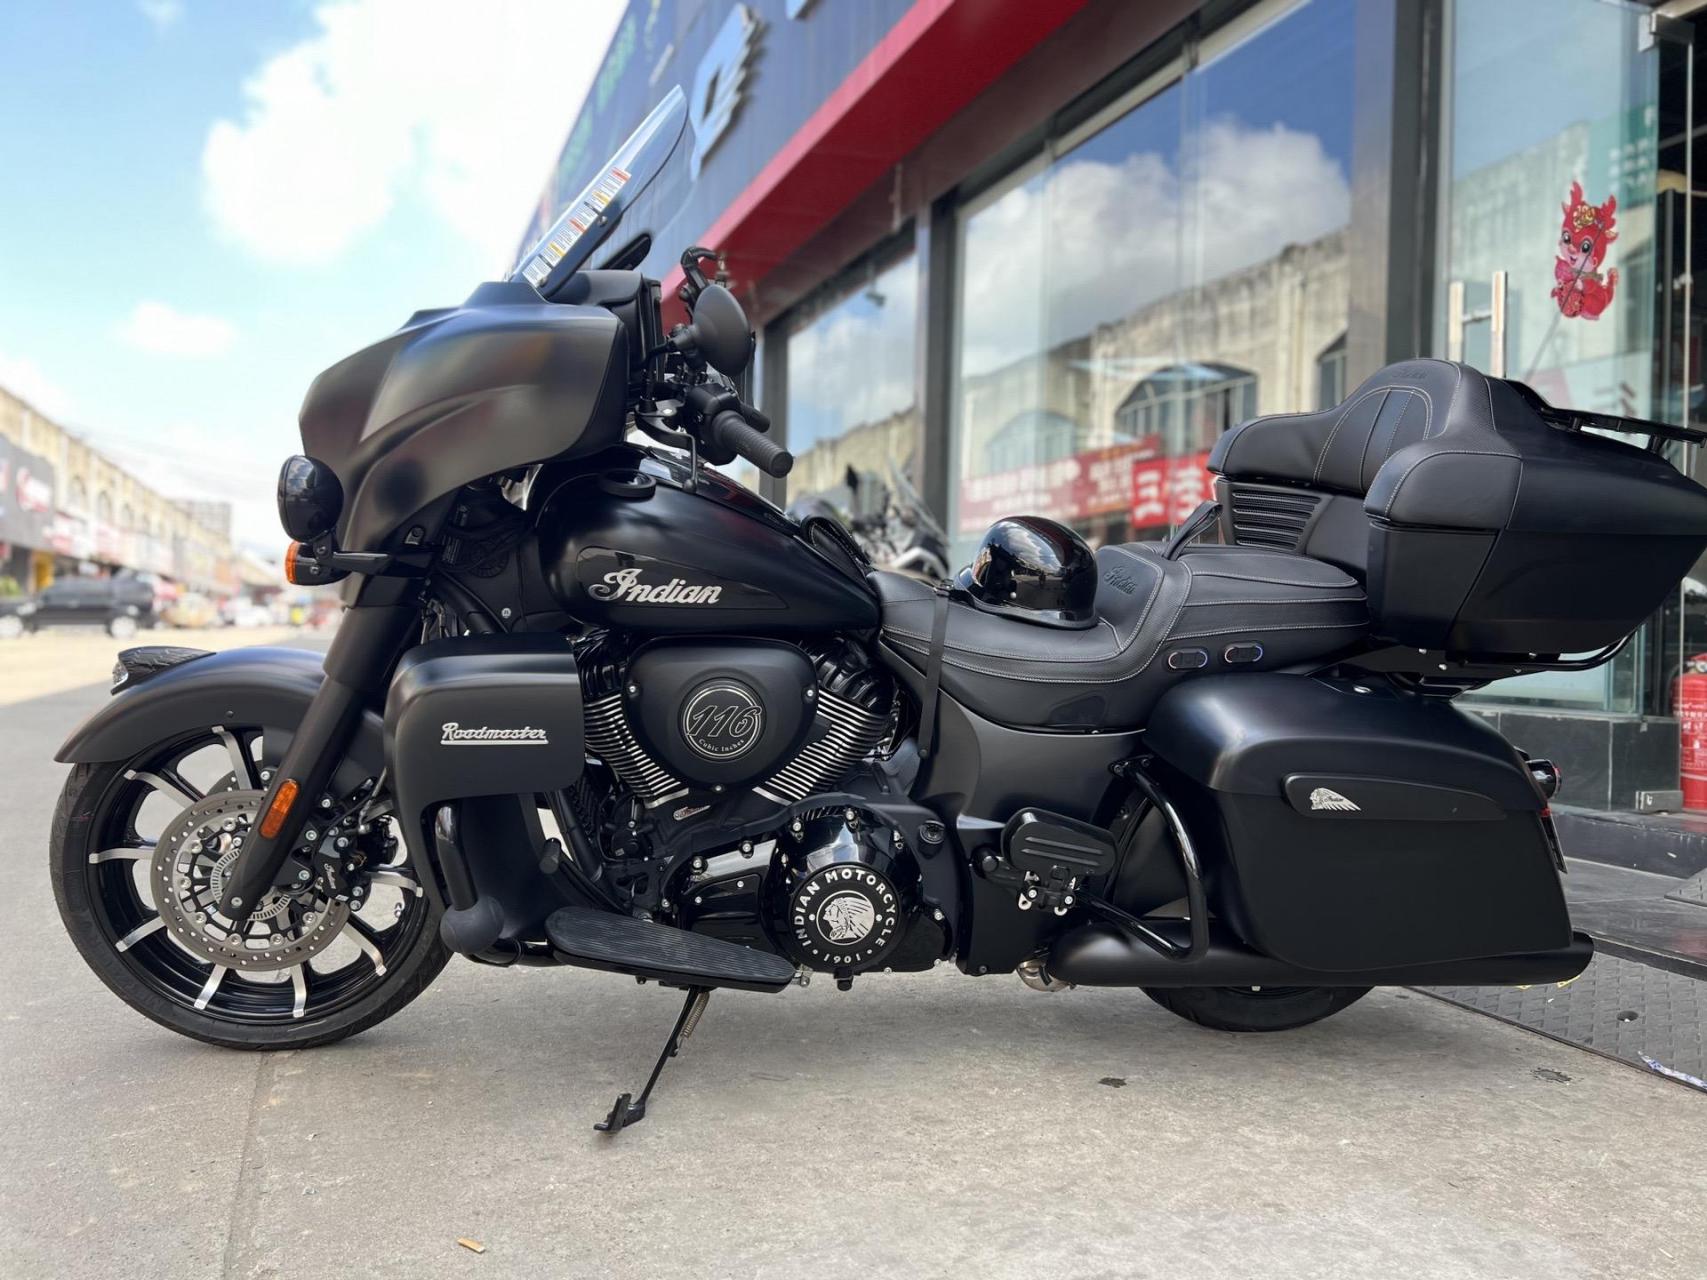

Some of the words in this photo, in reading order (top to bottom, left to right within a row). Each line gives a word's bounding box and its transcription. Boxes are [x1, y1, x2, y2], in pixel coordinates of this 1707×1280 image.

[588, 568, 722, 604] Indian
[441, 722, 548, 741] Roadmaster
[685, 705, 762, 737] 116
[794, 881, 820, 947] INDIAN
[825, 868, 896, 947] MOTORCYCLE
[823, 953, 861, 963] 1901
